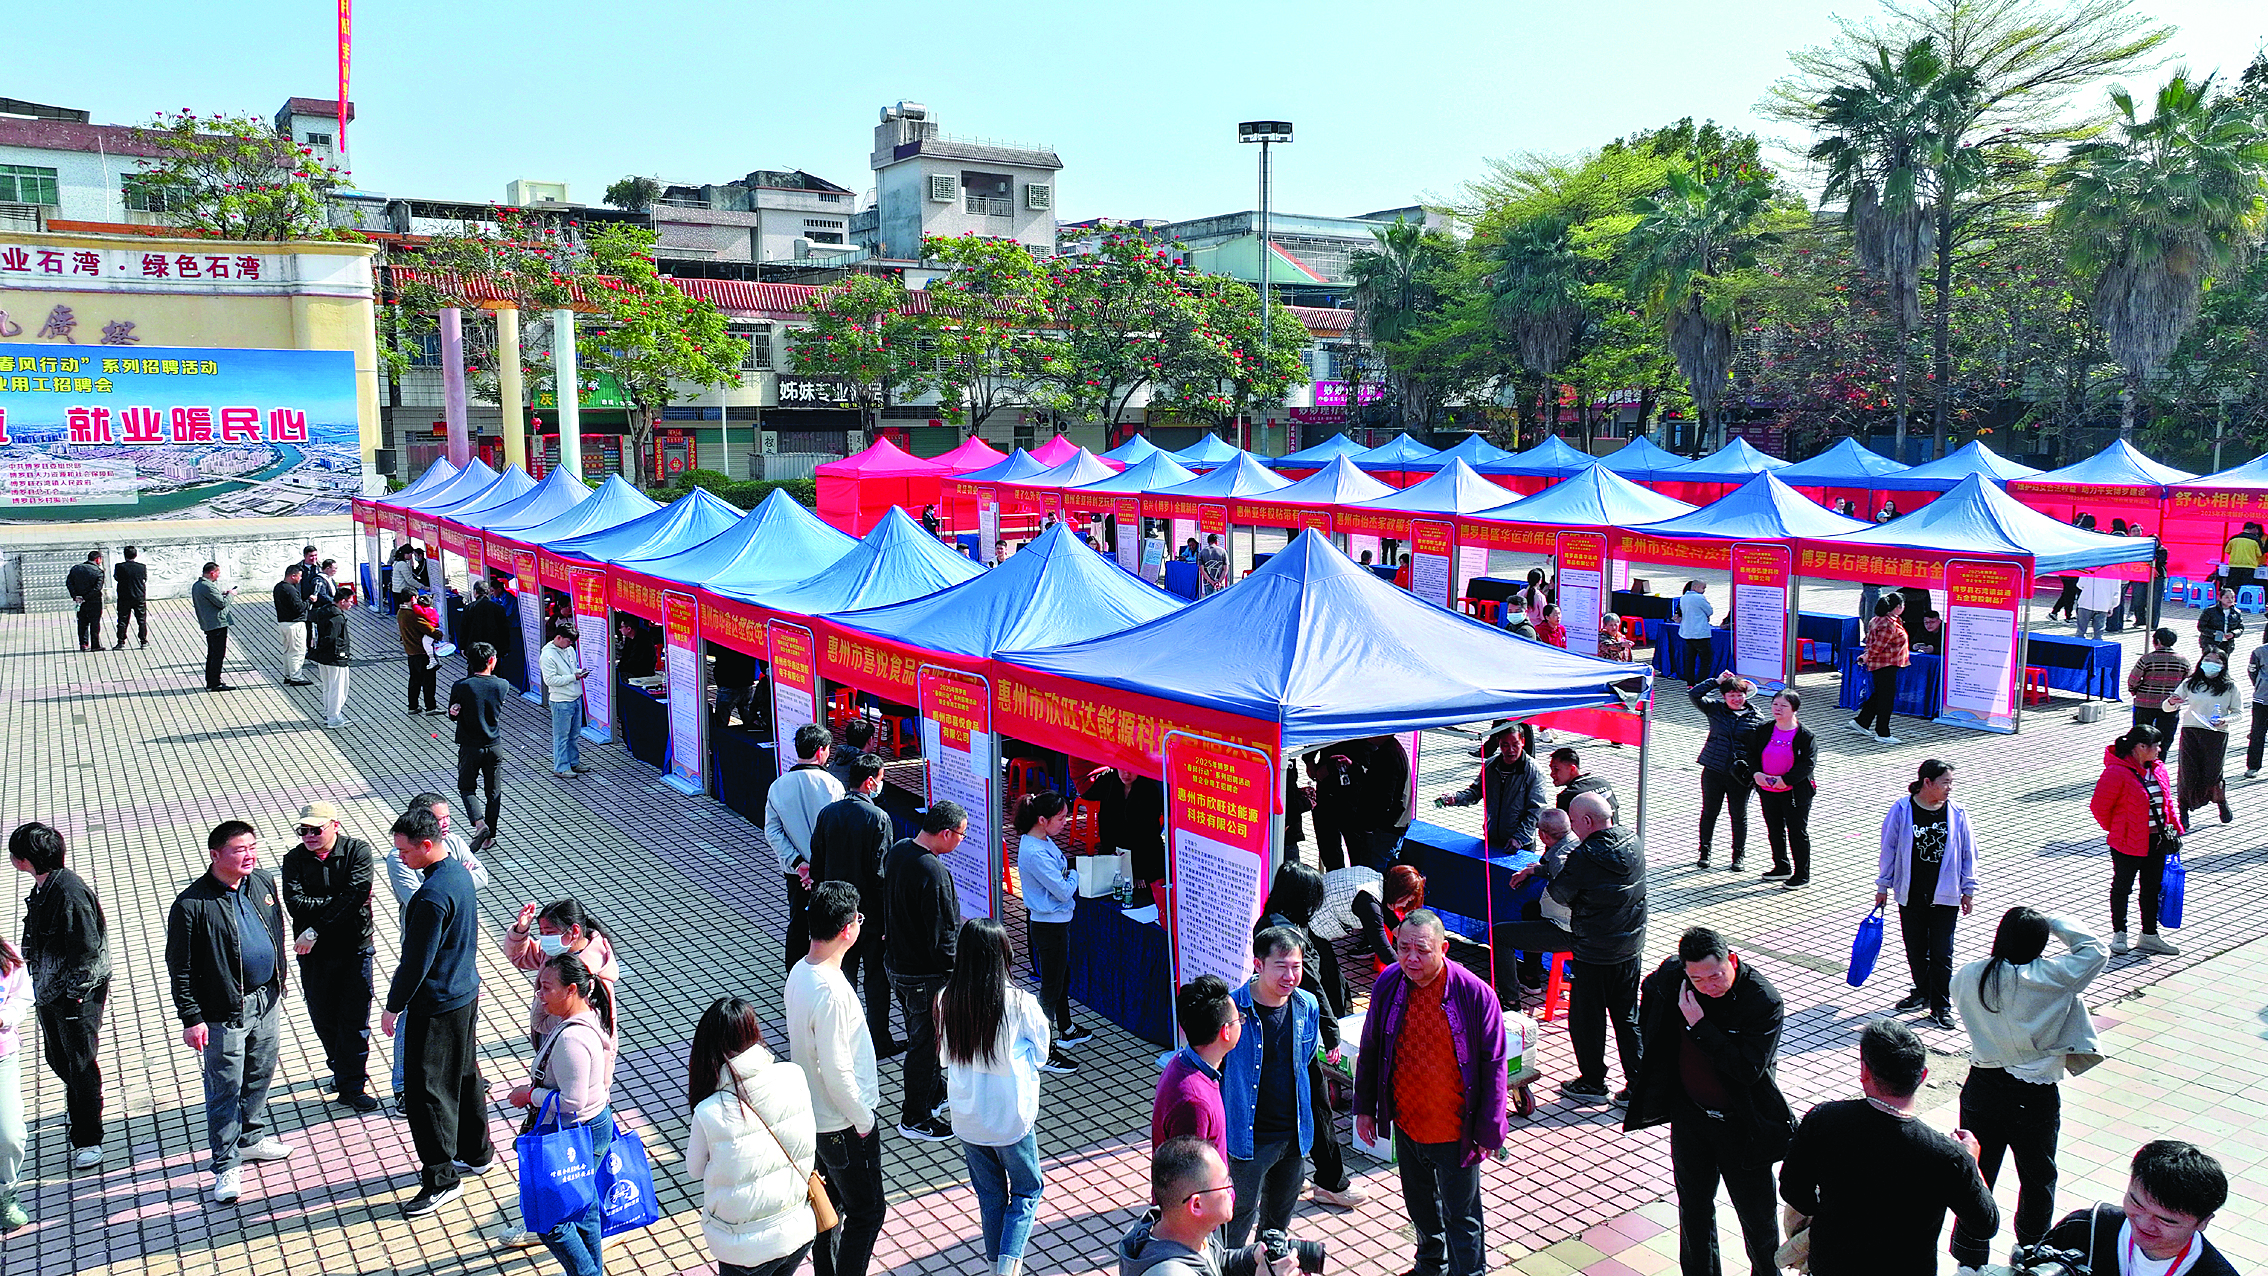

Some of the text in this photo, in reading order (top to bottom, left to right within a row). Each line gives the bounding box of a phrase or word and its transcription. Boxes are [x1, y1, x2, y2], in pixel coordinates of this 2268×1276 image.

[102, 358, 218, 375] 系列招聘活动
[66, 406, 311, 446] 就业暖民心
[2175, 491, 2249, 509] 舒心相伴
[942, 726, 970, 744] 有限公司
[1177, 787, 1259, 824] 惠州市欣旺达能源
[1187, 807, 1248, 838] 科技有限公司
